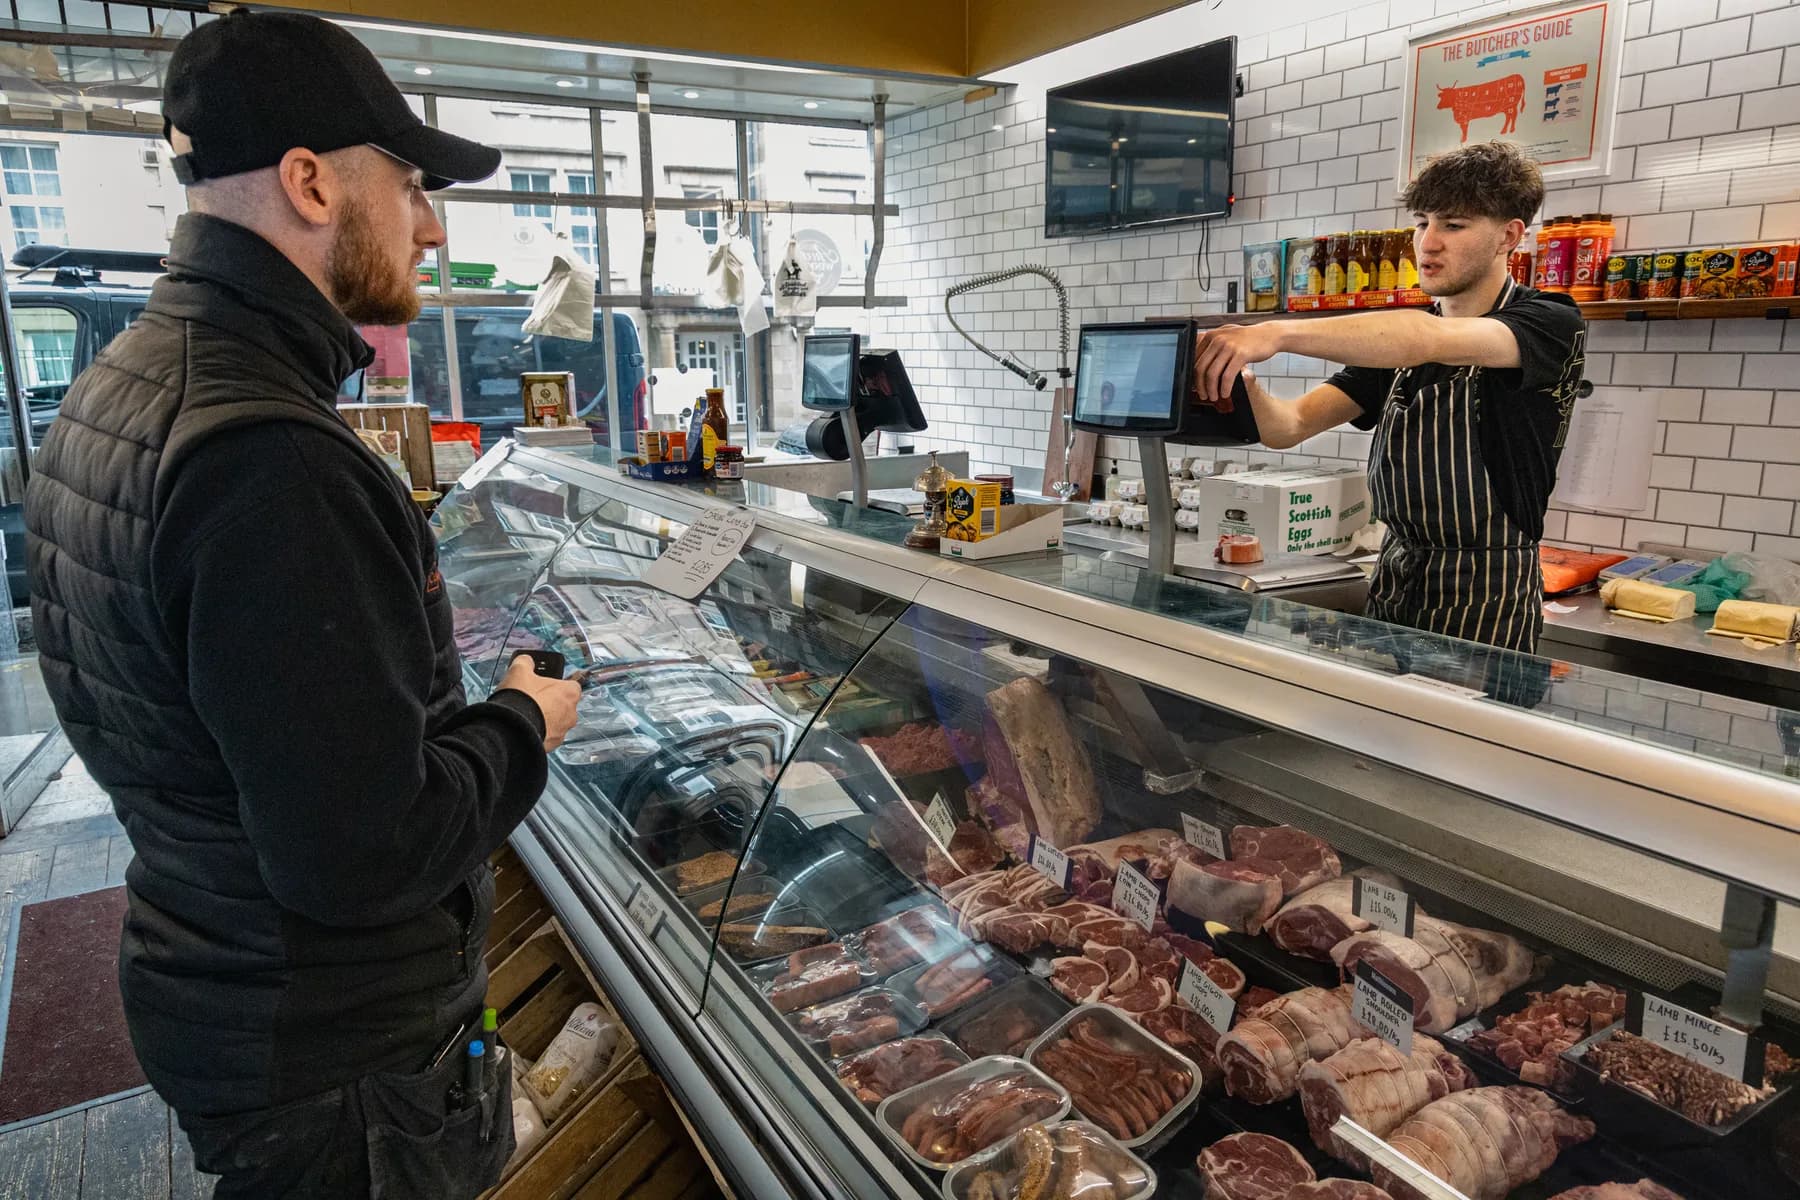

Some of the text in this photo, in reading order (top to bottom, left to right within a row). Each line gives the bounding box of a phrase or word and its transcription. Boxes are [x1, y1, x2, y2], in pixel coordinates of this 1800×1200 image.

[1443, 18, 1573, 62] THE BUTCHER'S GUIDE
[1577, 254, 1593, 263] Salt
[1289, 491, 1312, 505] True
[1289, 505, 1331, 523] Scottish
[1287, 543, 1302, 552] Only
[1304, 541, 1315, 549] the
[1317, 537, 1331, 547] shell
[1288, 528, 1312, 543] Eggs
[1121, 867, 1137, 884] LAMB
[1364, 882, 1395, 902] LAMB LEG
[1187, 966, 1223, 1000] LAMB GIGOT
[1192, 981, 1208, 997] CHOPS
[1357, 981, 1377, 1001] LAMB
[1380, 997, 1407, 1021] ROLLED
[1365, 998, 1400, 1027] SHOULDER
[1648, 1000, 1722, 1036] LAMB MINCE
